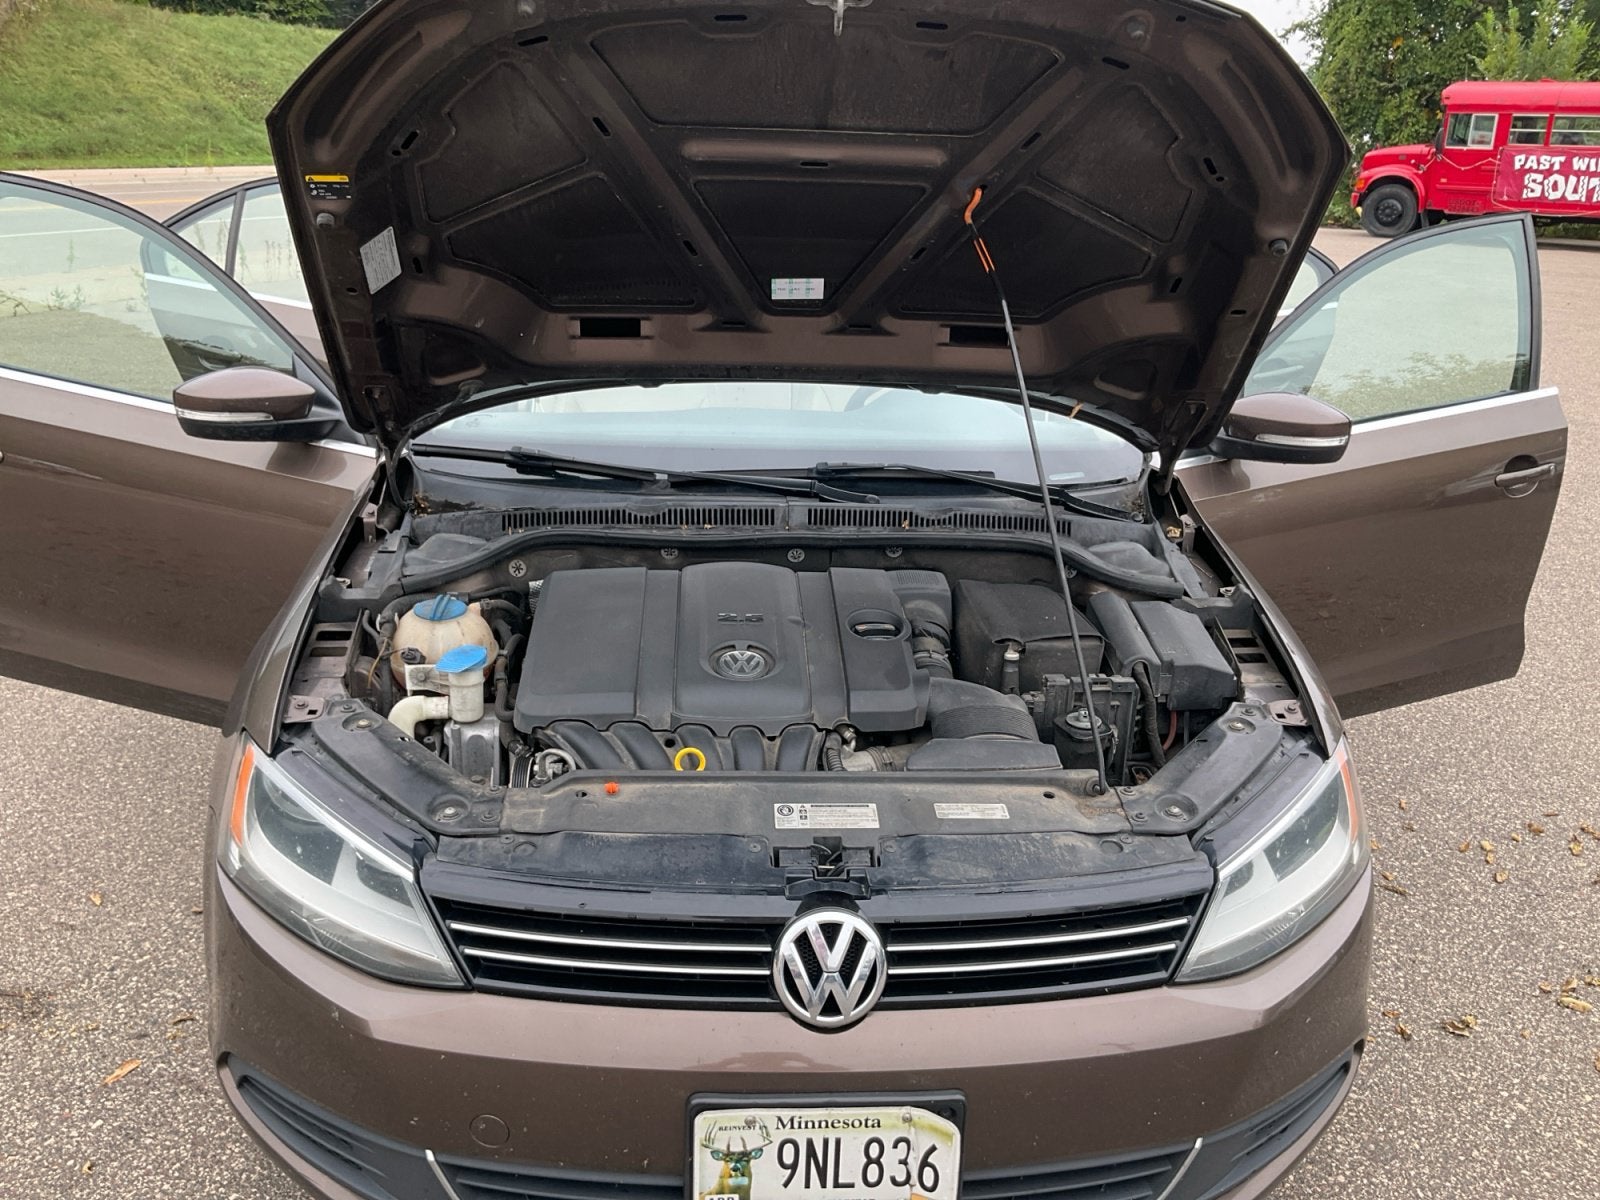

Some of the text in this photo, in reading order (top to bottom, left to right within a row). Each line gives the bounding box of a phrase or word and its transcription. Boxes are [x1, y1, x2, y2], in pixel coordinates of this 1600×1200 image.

[1514, 154, 1600, 173] PAST WI
[718, 612, 764, 624] 2.5
[719, 650, 765, 677] VW
[773, 909, 887, 1027] VW
[718, 1124, 757, 1132] REINVEST
[775, 1114, 882, 1130] Minnesota
[776, 1136, 940, 1193] 9NL836
